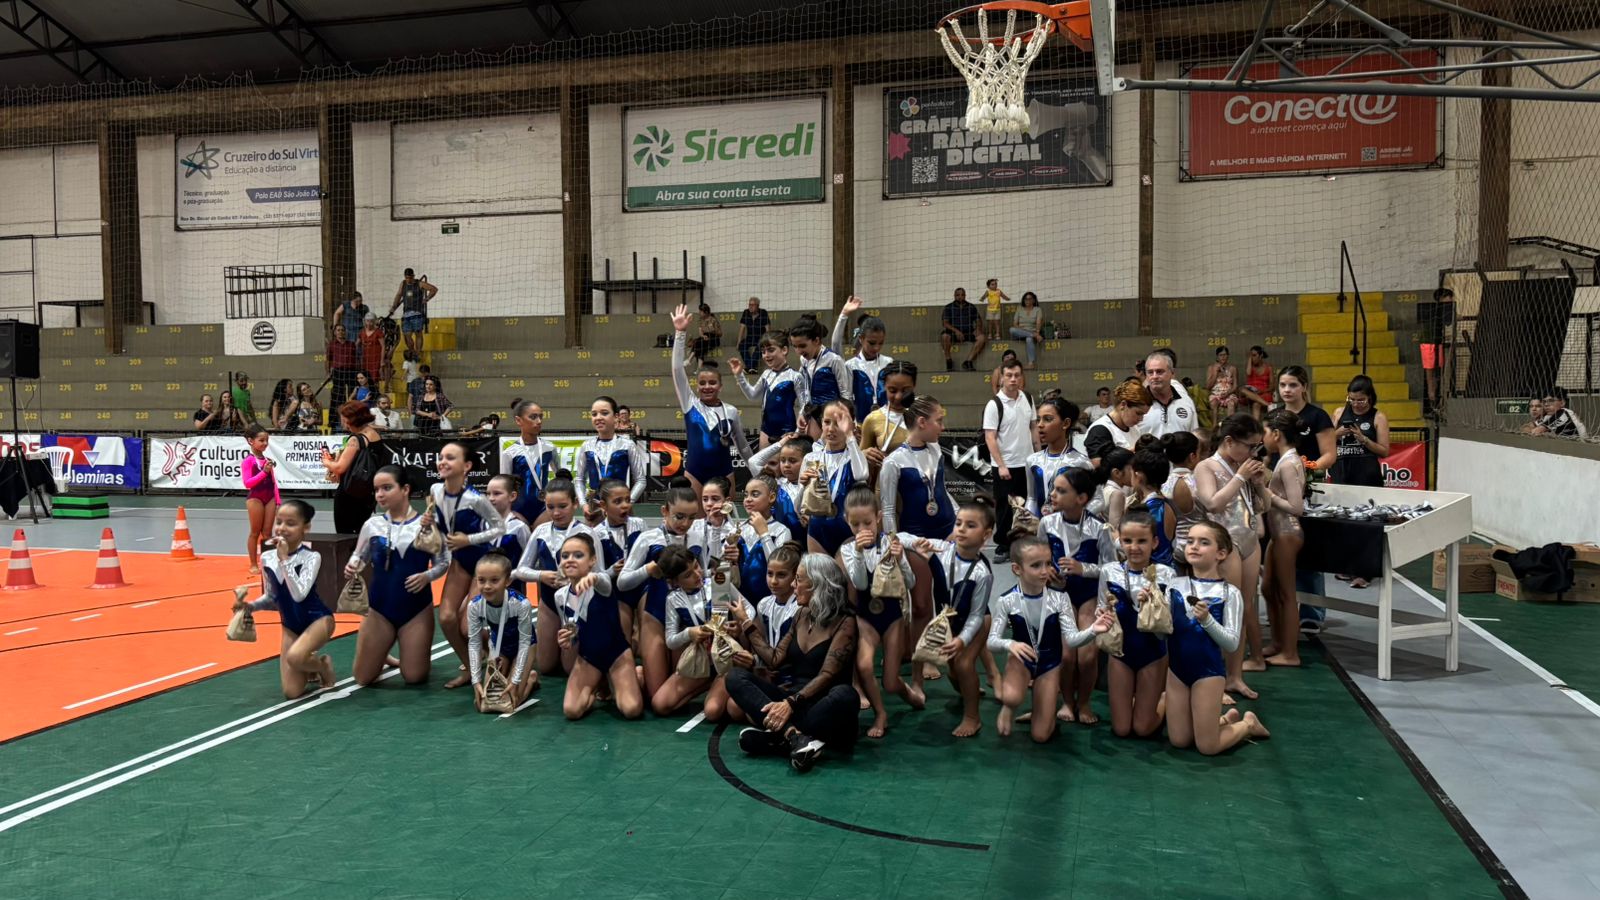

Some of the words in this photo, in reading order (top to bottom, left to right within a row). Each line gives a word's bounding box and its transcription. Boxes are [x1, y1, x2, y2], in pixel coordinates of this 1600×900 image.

[1224, 86, 1397, 125] Conect@
[900, 115, 969, 134] GRÁFIC
[1257, 125, 1291, 134] internet
[1292, 123, 1326, 134] começa
[682, 122, 816, 163] Sicredi
[224, 150, 267, 163] Cruzeiro
[268, 149, 281, 161] do
[282, 148, 298, 160] Sul
[299, 148, 320, 160] Virt
[946, 143, 1042, 166] DIGITAL
[1276, 154, 1305, 163] RÁPIDA
[1306, 152, 1348, 161] INTERNET!
[224, 166, 258, 176] Educação
[265, 164, 297, 173] distância
[656, 190, 685, 201] Abra
[687, 190, 710, 200] sua
[712, 187, 748, 198] conta
[750, 184, 792, 197] isenta
[1096, 340, 1116, 348] 290
[1152, 338, 1172, 347] 289
[1208, 338, 1226, 346] 288
[1264, 336, 1284, 344] 287
[931, 376, 950, 384] 257
[1038, 374, 1058, 382] 255
[1094, 372, 1114, 380] 254
[294, 440, 328, 450] POUSADA
[286, 452, 323, 462] PRIMAVER
[200, 462, 241, 480] ingles
[64, 470, 124, 484] eleminas
